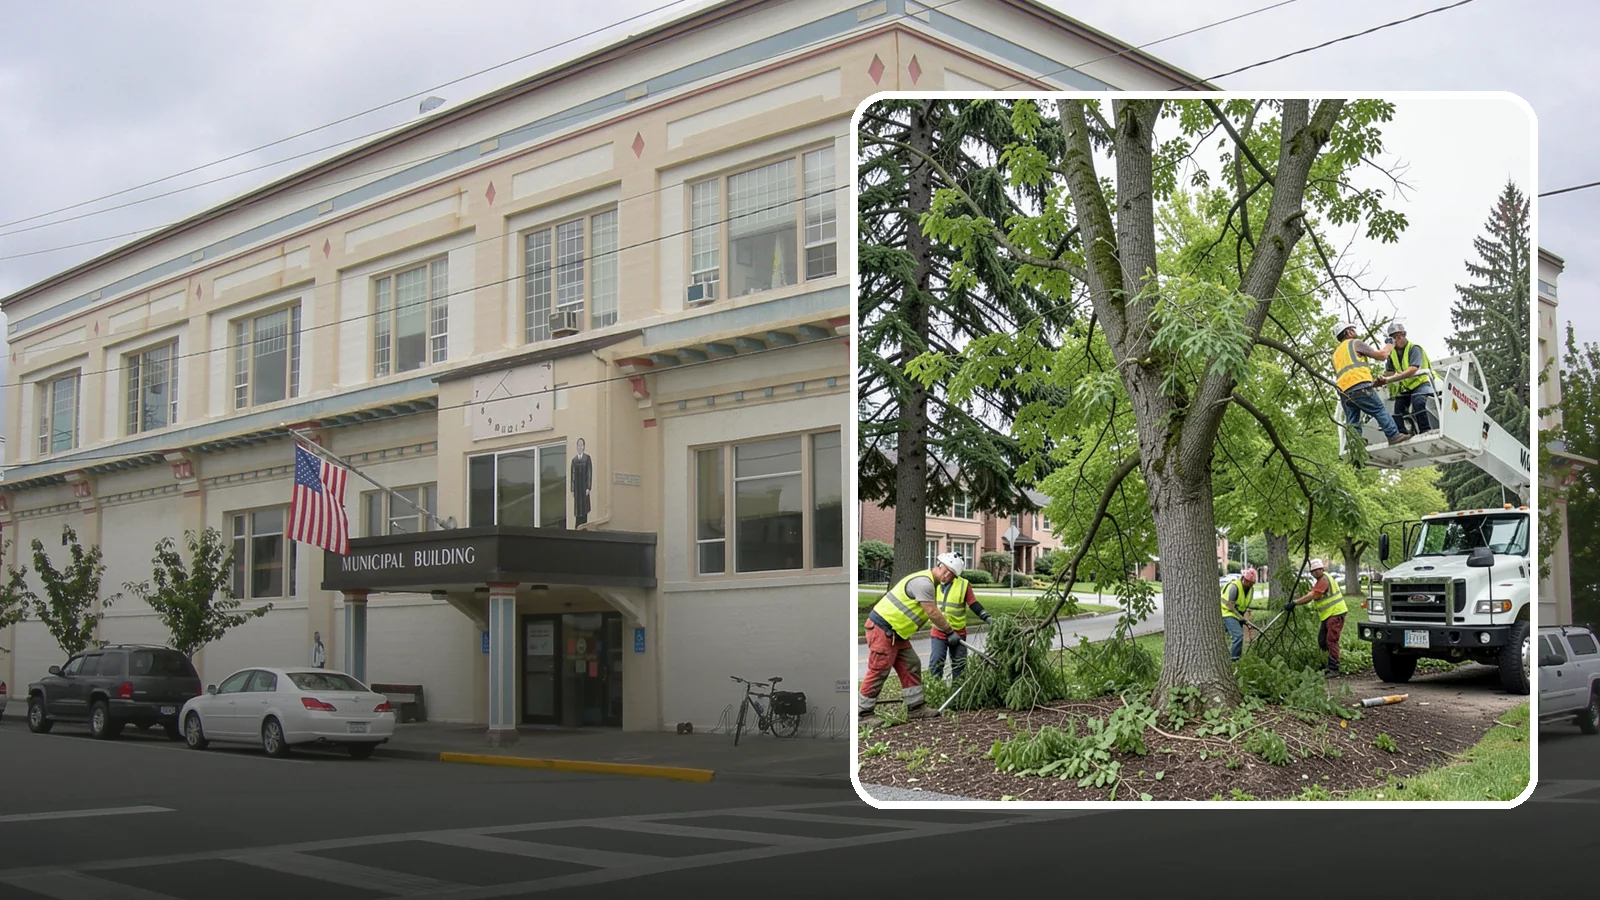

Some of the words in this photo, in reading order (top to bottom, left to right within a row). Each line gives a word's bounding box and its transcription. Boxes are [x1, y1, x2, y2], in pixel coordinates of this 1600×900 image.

[536, 402, 540, 410] 4
[481, 407, 485, 415] 8
[488, 417, 492, 425] 9
[529, 414, 533, 422] 3
[521, 420, 525, 428] 2
[494, 423, 500, 432] 10
[501, 425, 506, 434] 11
[507, 425, 513, 433] 12
[342, 552, 405, 572] MUNICIPAL
[414, 546, 475, 567] BUILDING
